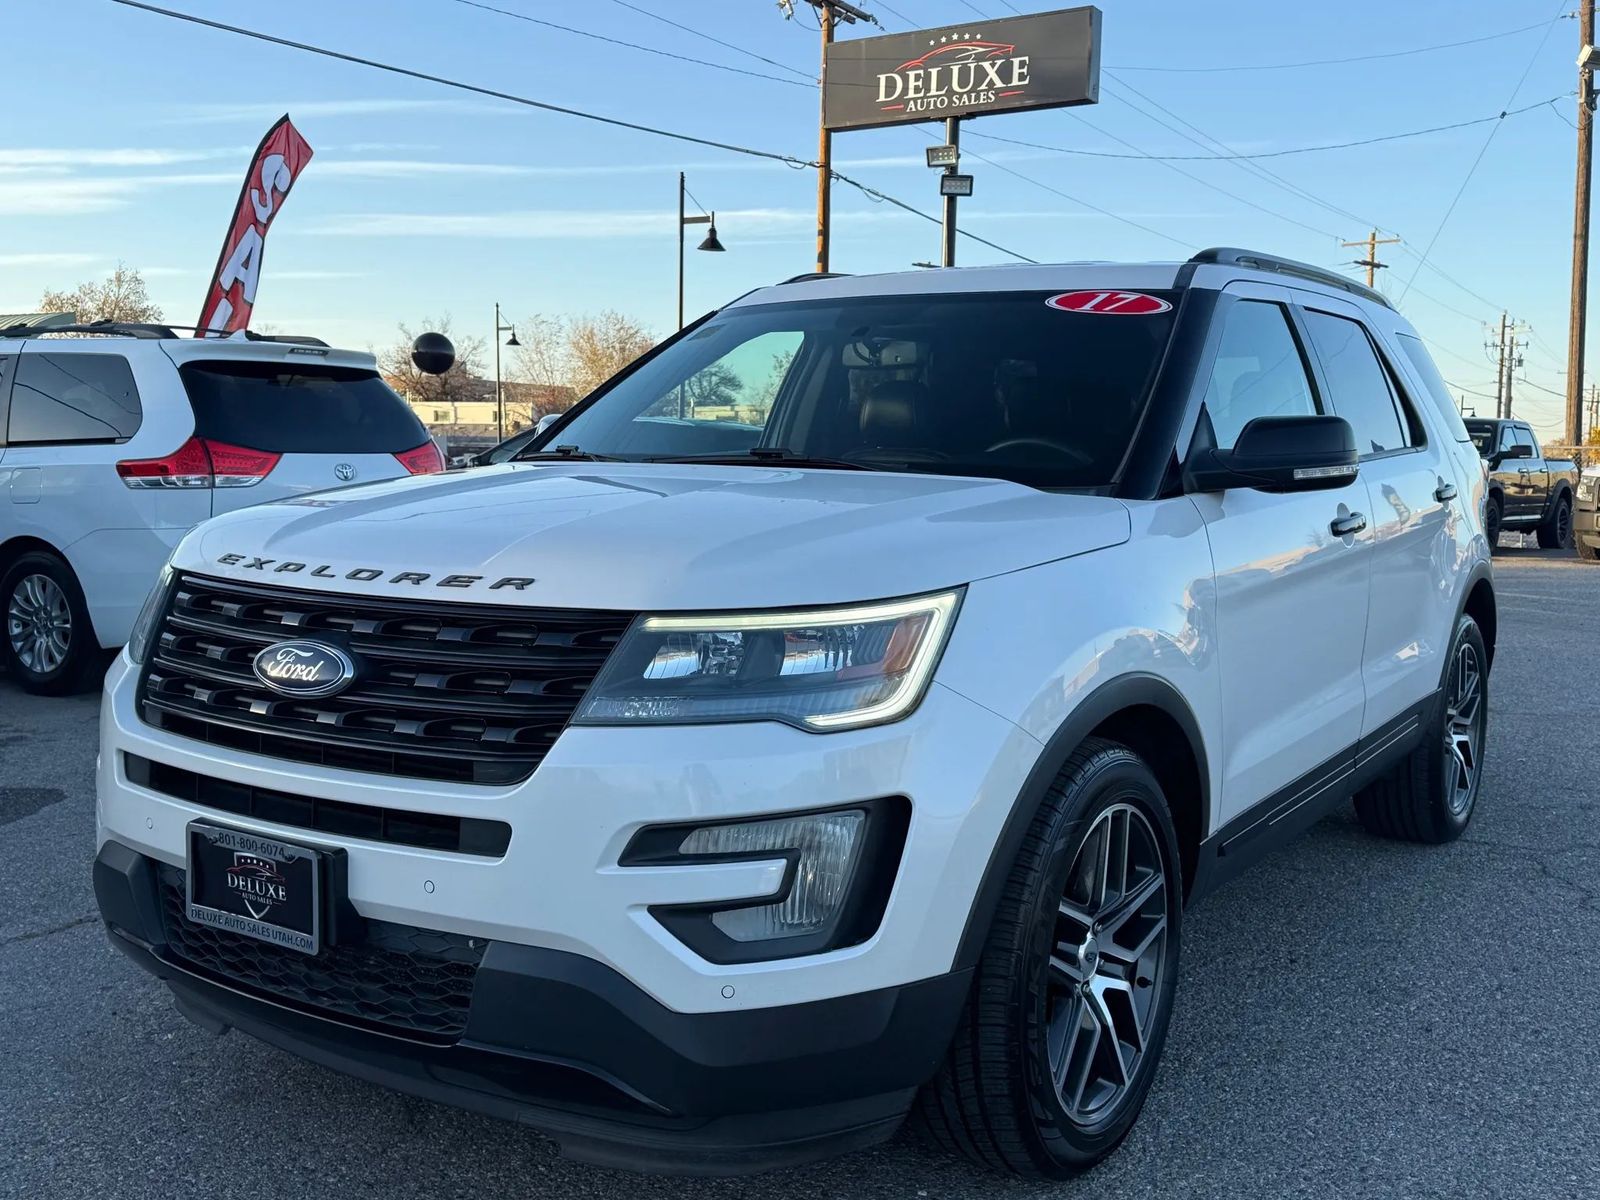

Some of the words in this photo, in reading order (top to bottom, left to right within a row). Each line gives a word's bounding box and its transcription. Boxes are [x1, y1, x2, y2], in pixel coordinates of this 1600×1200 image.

[876, 56, 1030, 102] DELUXE
[906, 97, 948, 112] AUTO
[952, 90, 996, 107] SALES
[1074, 292, 1141, 311] 17
[217, 552, 536, 591] EXPLORER
[267, 648, 324, 682] Ford
[218, 832, 286, 858] 801-800-6074
[227, 872, 287, 901] DELUXE
[191, 908, 223, 924] DELUXE
[224, 917, 246, 931] AUTO
[247, 922, 271, 938] SALES
[271, 930, 314, 950] UTAH.COM
